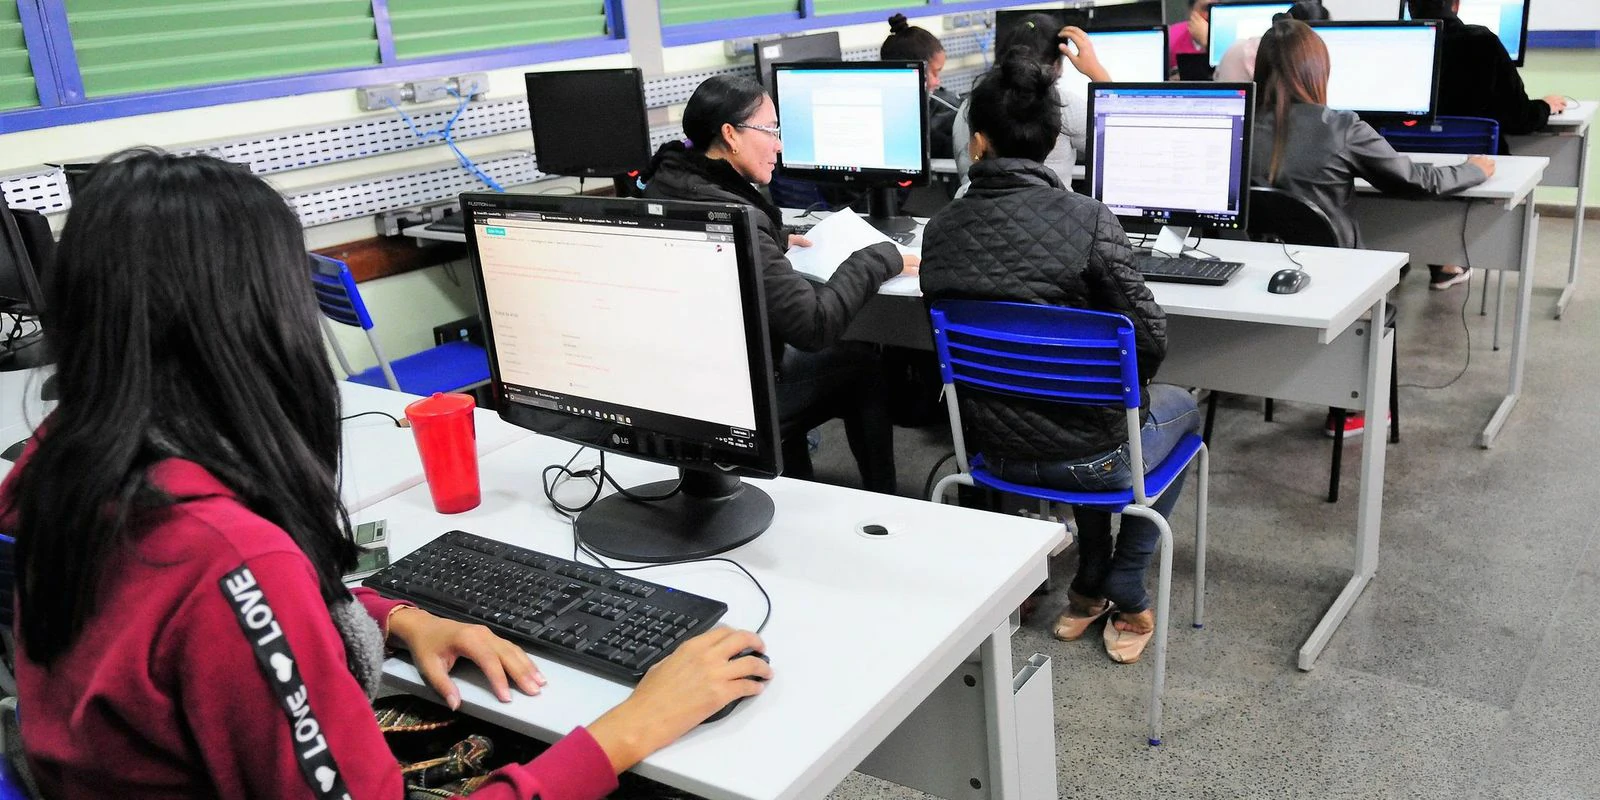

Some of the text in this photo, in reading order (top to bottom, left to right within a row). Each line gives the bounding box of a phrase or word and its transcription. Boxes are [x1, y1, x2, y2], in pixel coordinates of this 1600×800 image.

[620, 436, 630, 445] LG
[226, 568, 283, 646] LOVE
[286, 684, 328, 760] LOVE
